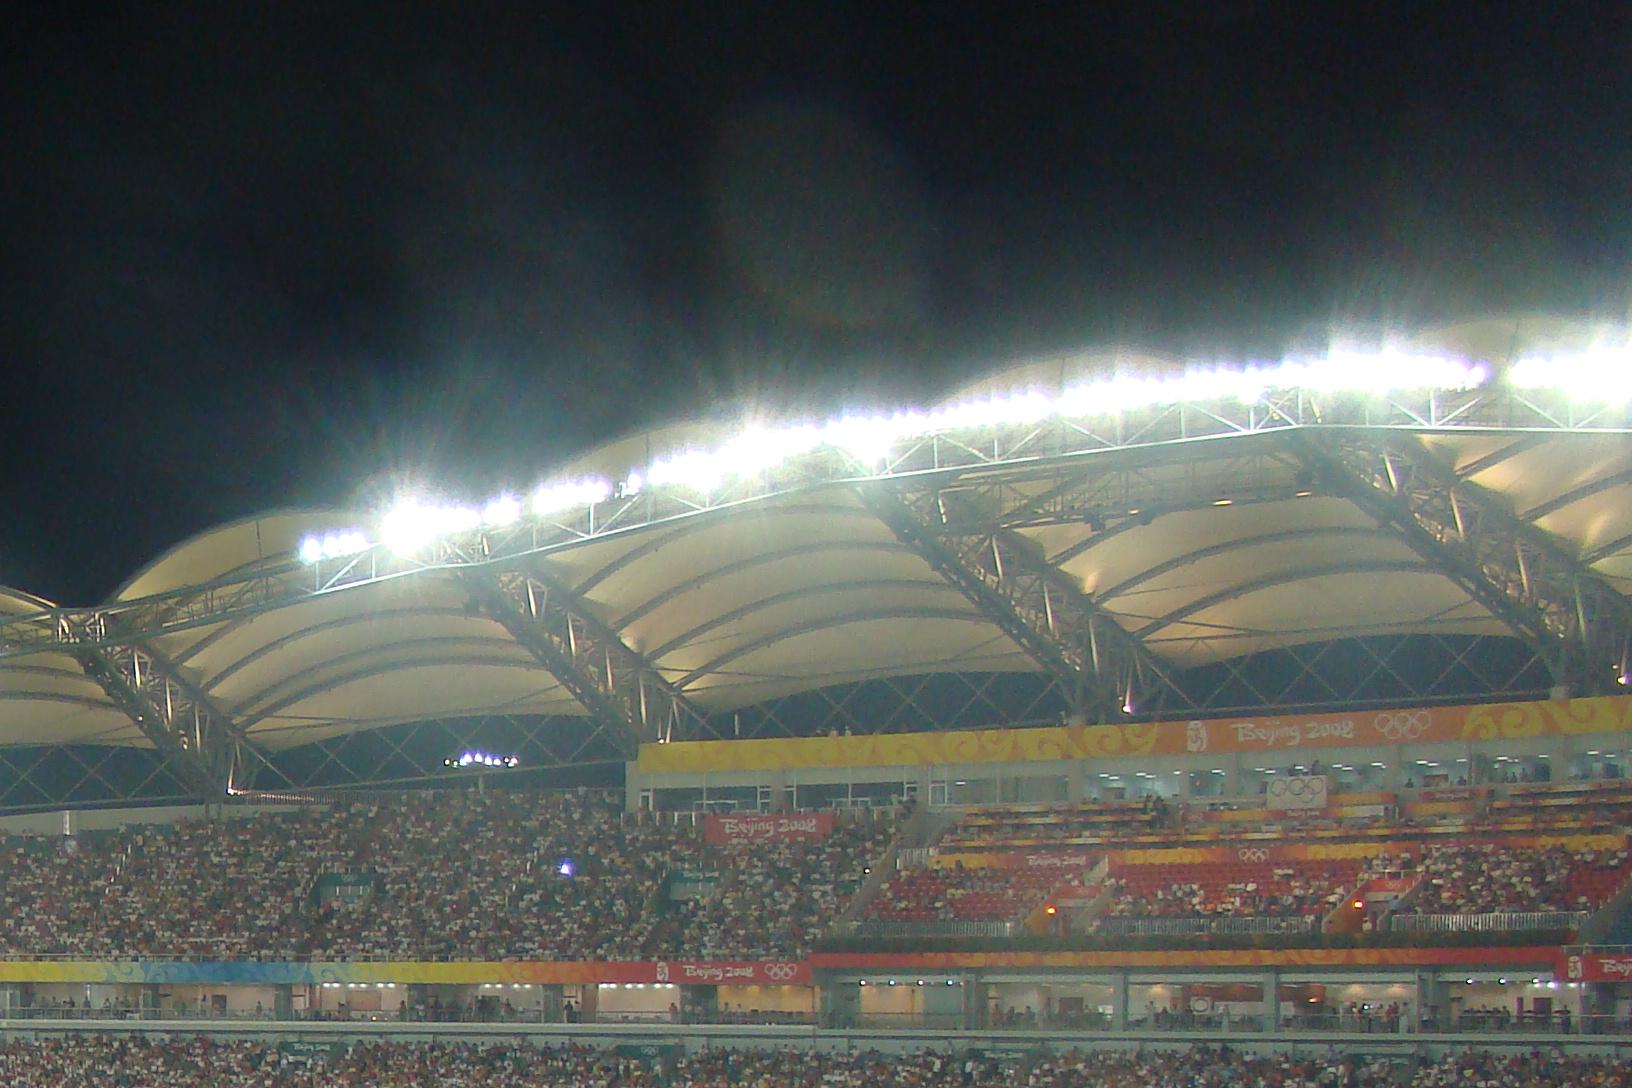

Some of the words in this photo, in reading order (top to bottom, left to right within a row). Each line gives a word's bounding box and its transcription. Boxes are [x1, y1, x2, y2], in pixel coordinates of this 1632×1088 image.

[1229, 720, 1301, 746] Beijing
[1305, 720, 1355, 739] 2008
[719, 817, 774, 838] Beijing
[778, 817, 818, 834] 2008
[682, 964, 724, 981] Beijing
